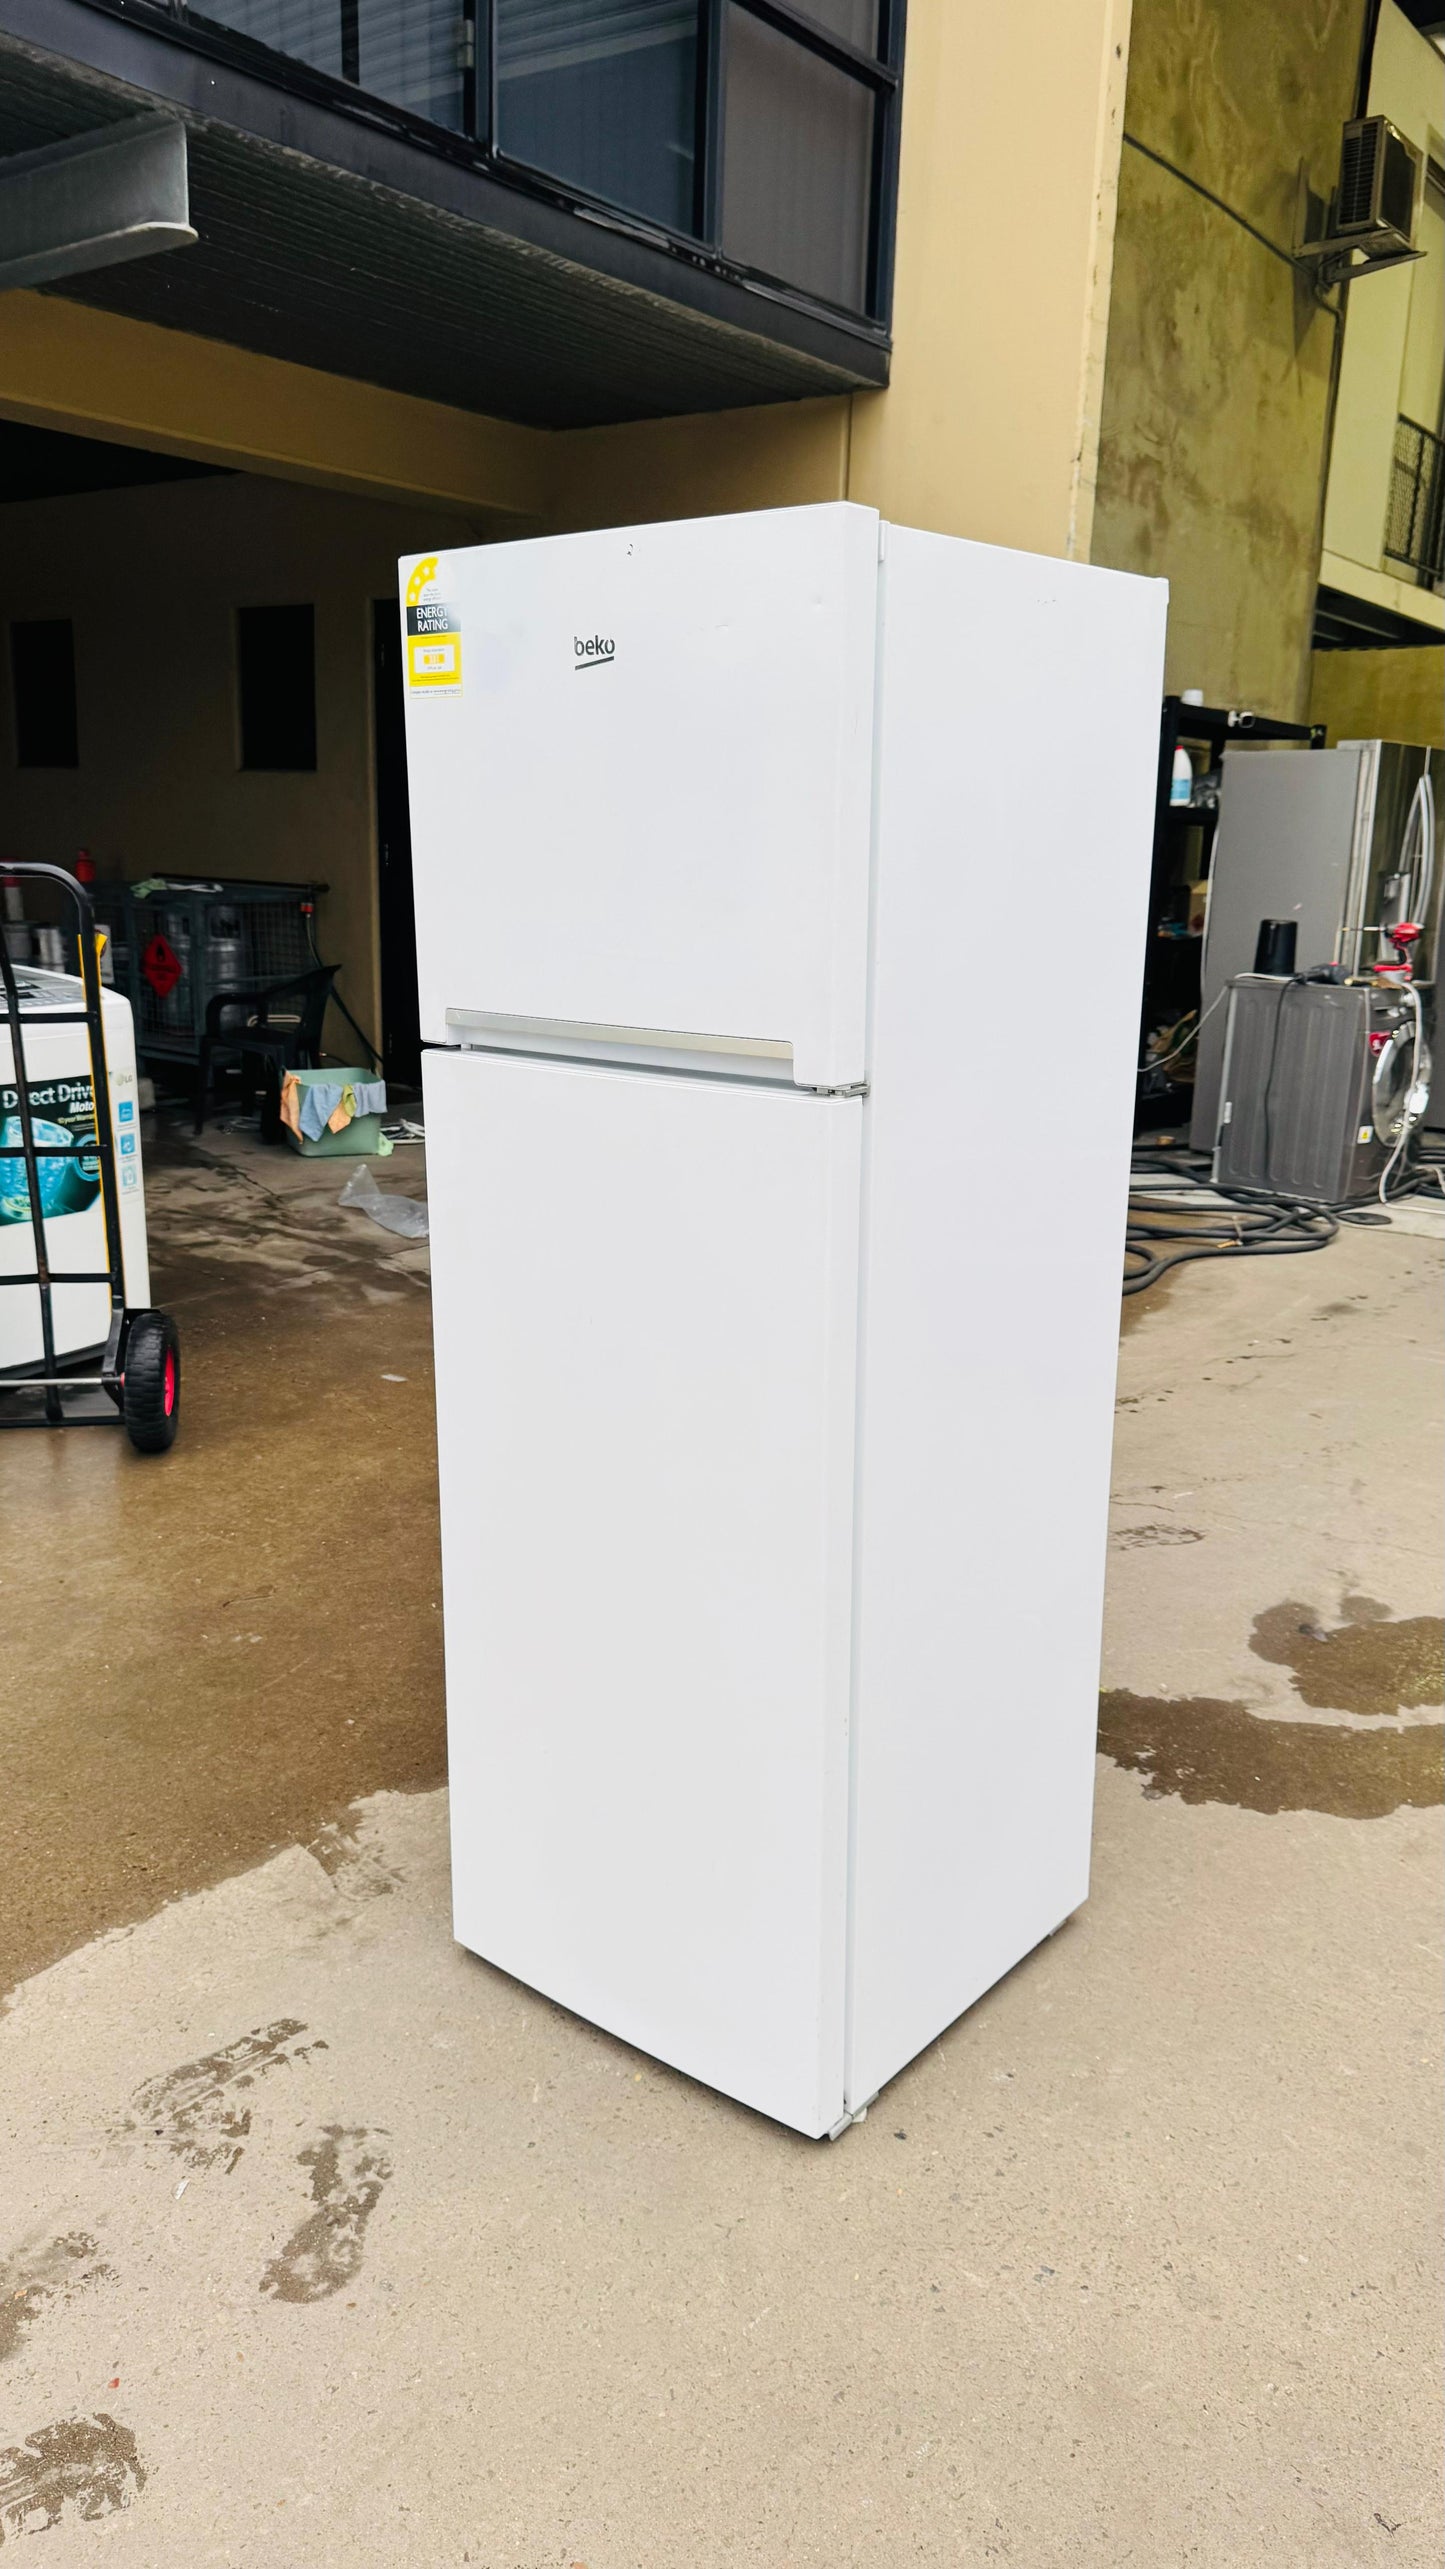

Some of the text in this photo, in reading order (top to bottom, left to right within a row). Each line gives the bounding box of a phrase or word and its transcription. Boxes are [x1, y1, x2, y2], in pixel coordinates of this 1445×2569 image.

[417, 618, 449, 632] RATING
[574, 634, 615, 656] beko
[2, 1086, 57, 1109] Dect
[69, 1101, 95, 1114] Moto
